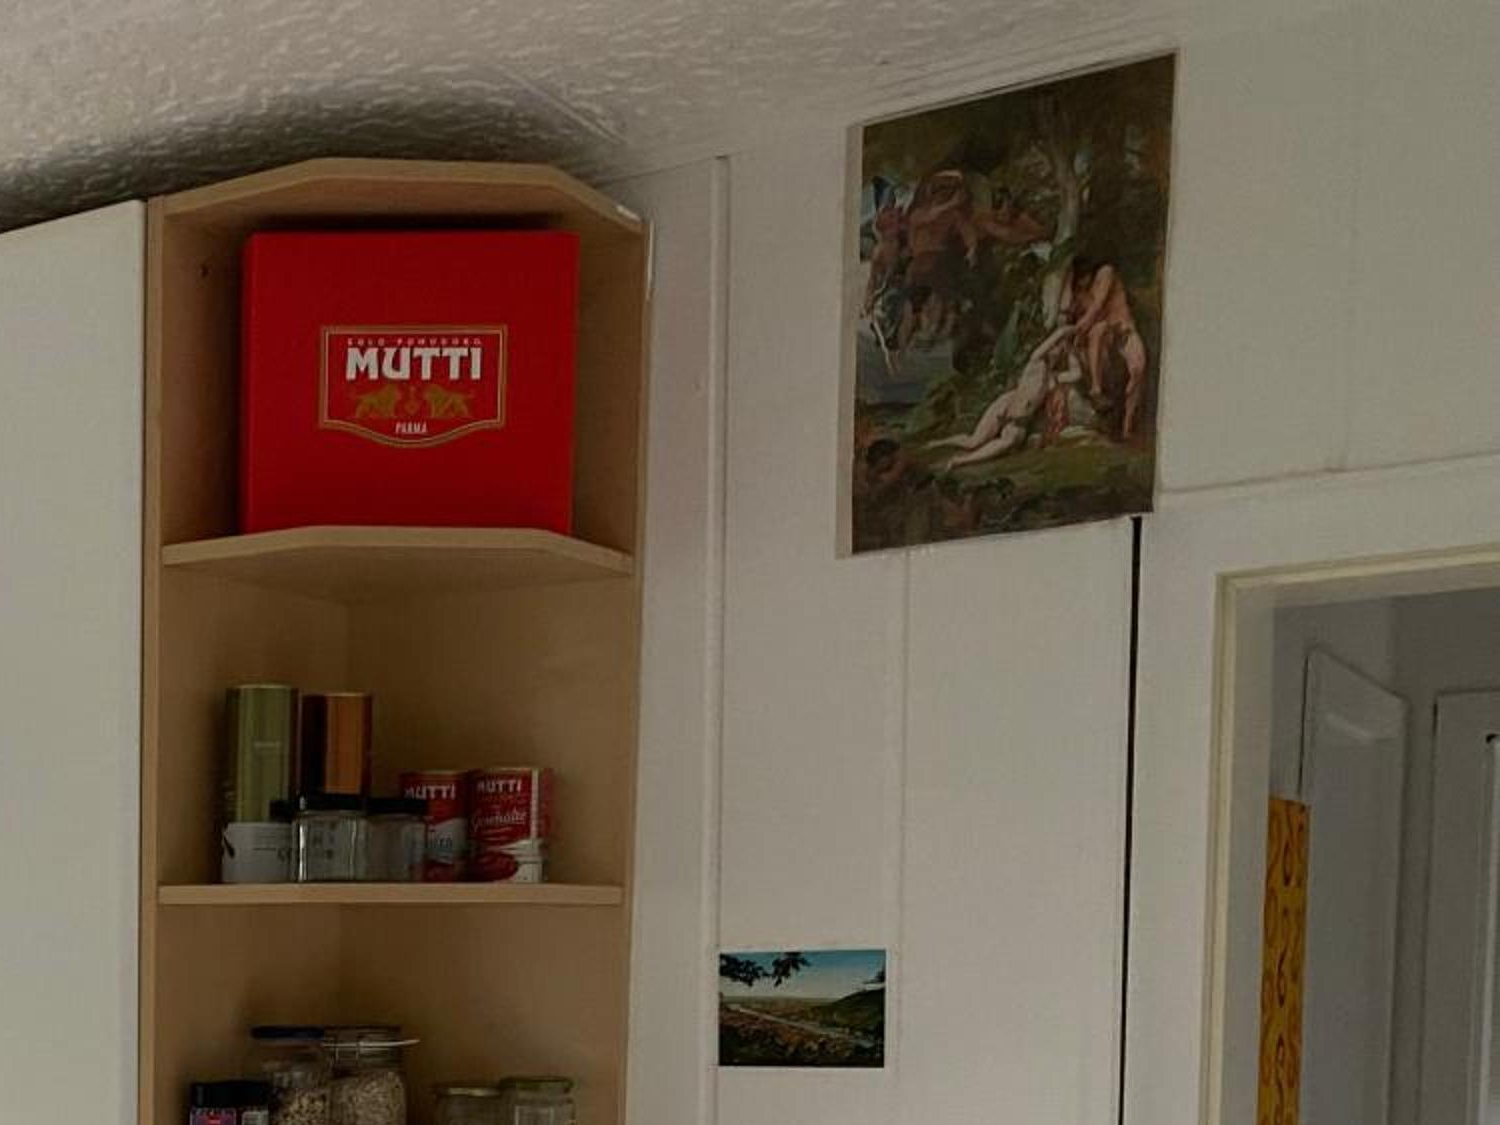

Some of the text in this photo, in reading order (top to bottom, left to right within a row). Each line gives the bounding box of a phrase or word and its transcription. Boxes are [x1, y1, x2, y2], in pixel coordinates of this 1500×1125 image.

[345, 347, 483, 381] MUTTI
[395, 421, 428, 434] PARMA
[404, 783, 456, 800] MUTTI
[476, 778, 522, 793] MUTTI
